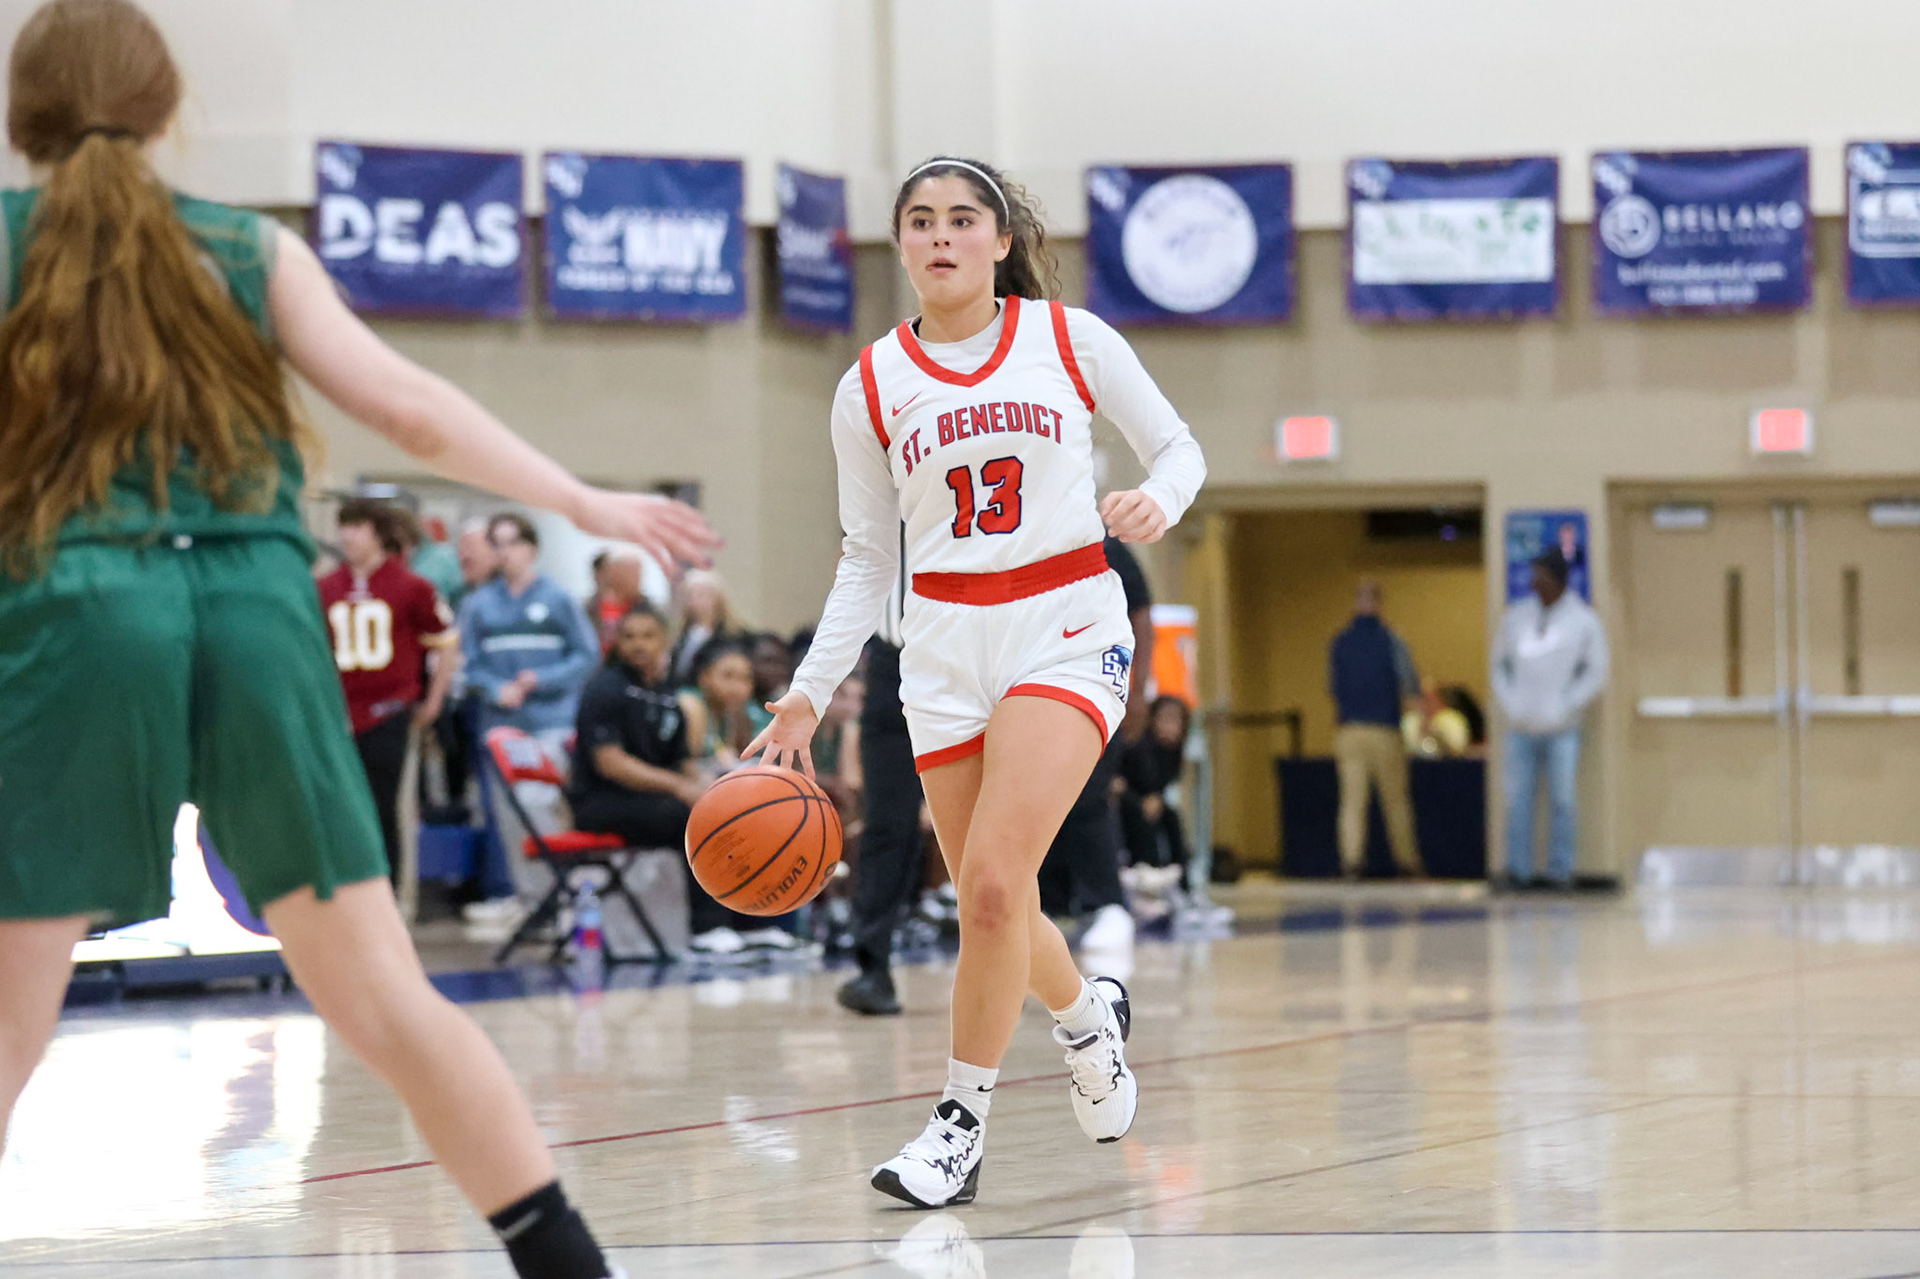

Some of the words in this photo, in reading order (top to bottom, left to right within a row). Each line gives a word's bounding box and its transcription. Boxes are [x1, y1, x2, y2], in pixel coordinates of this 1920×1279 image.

[319, 193, 521, 268] DEAS
[902, 428, 931, 477] ST.
[937, 402, 1063, 447] BENEDICT
[945, 455, 1024, 539] 13
[328, 599, 394, 672] 10
